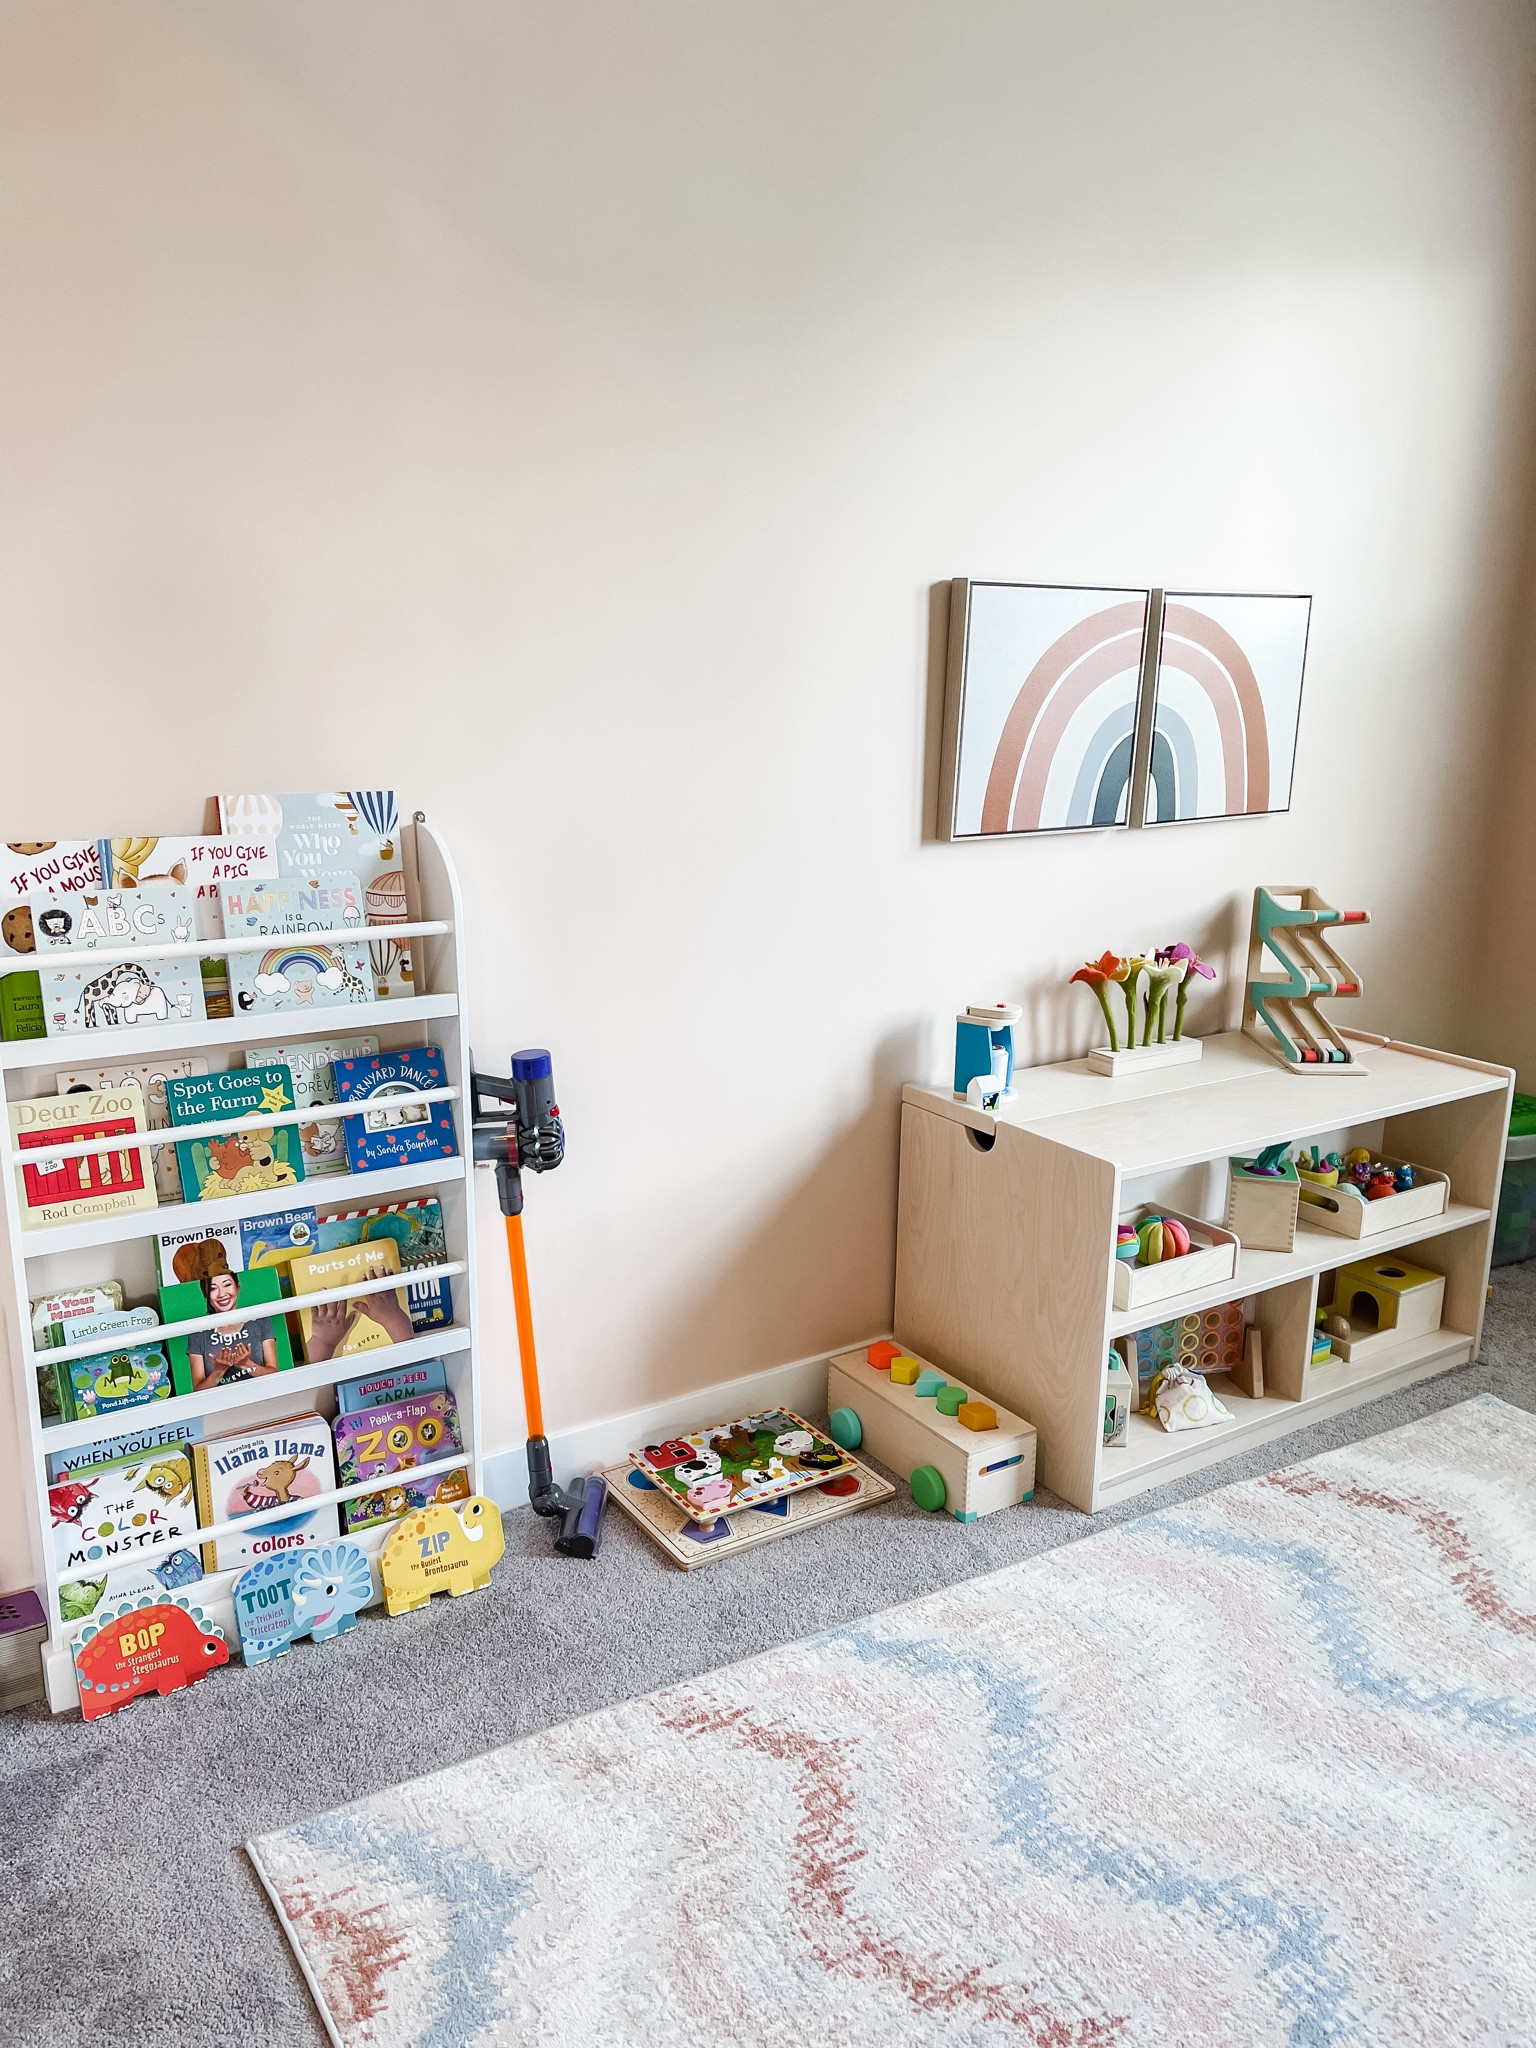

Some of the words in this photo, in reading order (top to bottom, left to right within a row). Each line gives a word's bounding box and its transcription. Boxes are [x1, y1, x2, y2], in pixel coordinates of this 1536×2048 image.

[191, 846, 205, 861] IF
[208, 845, 232, 860] YOU
[236, 846, 268, 861] GIVE
[292, 833, 341, 856] Who
[283, 849, 322, 867] You
[11, 872, 28, 894] IF
[30, 859, 60, 884] YOU
[62, 845, 100, 870] GIVE
[60, 866, 103, 892] MOUS
[212, 865, 220, 879] A
[224, 863, 249, 879] PIG
[197, 885, 206, 899] A
[228, 888, 356, 915] HAPPINESS
[87, 939, 97, 948] of
[14, 1003, 40, 1011] Laura
[16, 1022, 43, 1032] Felicia
[174, 1080, 215, 1099] Spot
[219, 1074, 261, 1091] Goes
[265, 1071, 283, 1083] to
[313, 1072, 321, 1080] IS
[349, 1066, 396, 1102] BARNYARD
[15, 1104, 80, 1126] Dear
[89, 1095, 133, 1116] Zoo
[176, 1101, 206, 1116] the
[210, 1094, 258, 1112] Farm
[366, 1148, 376, 1160] by
[377, 1144, 404, 1156] Sandra
[404, 1138, 439, 1152] Boynton
[40, 1206, 68, 1220] Rod
[72, 1195, 136, 1215] Campbell
[243, 1217, 284, 1232] Brown
[285, 1211, 315, 1225] Bear,
[161, 1232, 204, 1247] Brown
[205, 1225, 238, 1240] Bear,
[309, 1260, 345, 1276] Parts
[348, 1253, 361, 1267] of
[365, 1250, 384, 1263] Me
[47, 1303, 60, 1312] Is
[62, 1296, 95, 1309] Your
[51, 1306, 95, 1321] Mama
[72, 1325, 98, 1339] Little
[100, 1319, 128, 1331] Green
[131, 1316, 153, 1326] Frog
[210, 1329, 249, 1346] Signs
[359, 1378, 394, 1396] TOUCH
[402, 1372, 427, 1384] FEEL
[375, 1387, 415, 1405] FARM
[369, 1405, 427, 1428] Peek-a-Flap
[63, 1448, 113, 1470] WHEN
[118, 1437, 152, 1455] YOU
[158, 1427, 194, 1445] FEEL
[356, 1417, 442, 1463] ZOO
[214, 1446, 269, 1475] llama
[274, 1439, 325, 1457] llama
[104, 1500, 135, 1515] THE
[82, 1509, 168, 1541] COLOR
[68, 1527, 183, 1567] MONSTER
[253, 1533, 305, 1554] colors
[418, 1531, 450, 1558] ZIP
[421, 1556, 442, 1568] Busiest
[425, 1559, 469, 1577] Brontosaurus
[241, 1578, 291, 1613] TOOT
[250, 1618, 291, 1636] Triceratops
[256, 1608, 284, 1624] Trickiest
[119, 1622, 165, 1657] BOP
[115, 1661, 126, 1670] the
[128, 1648, 162, 1667] Strangest
[132, 1655, 179, 1676] Stegosaurus
